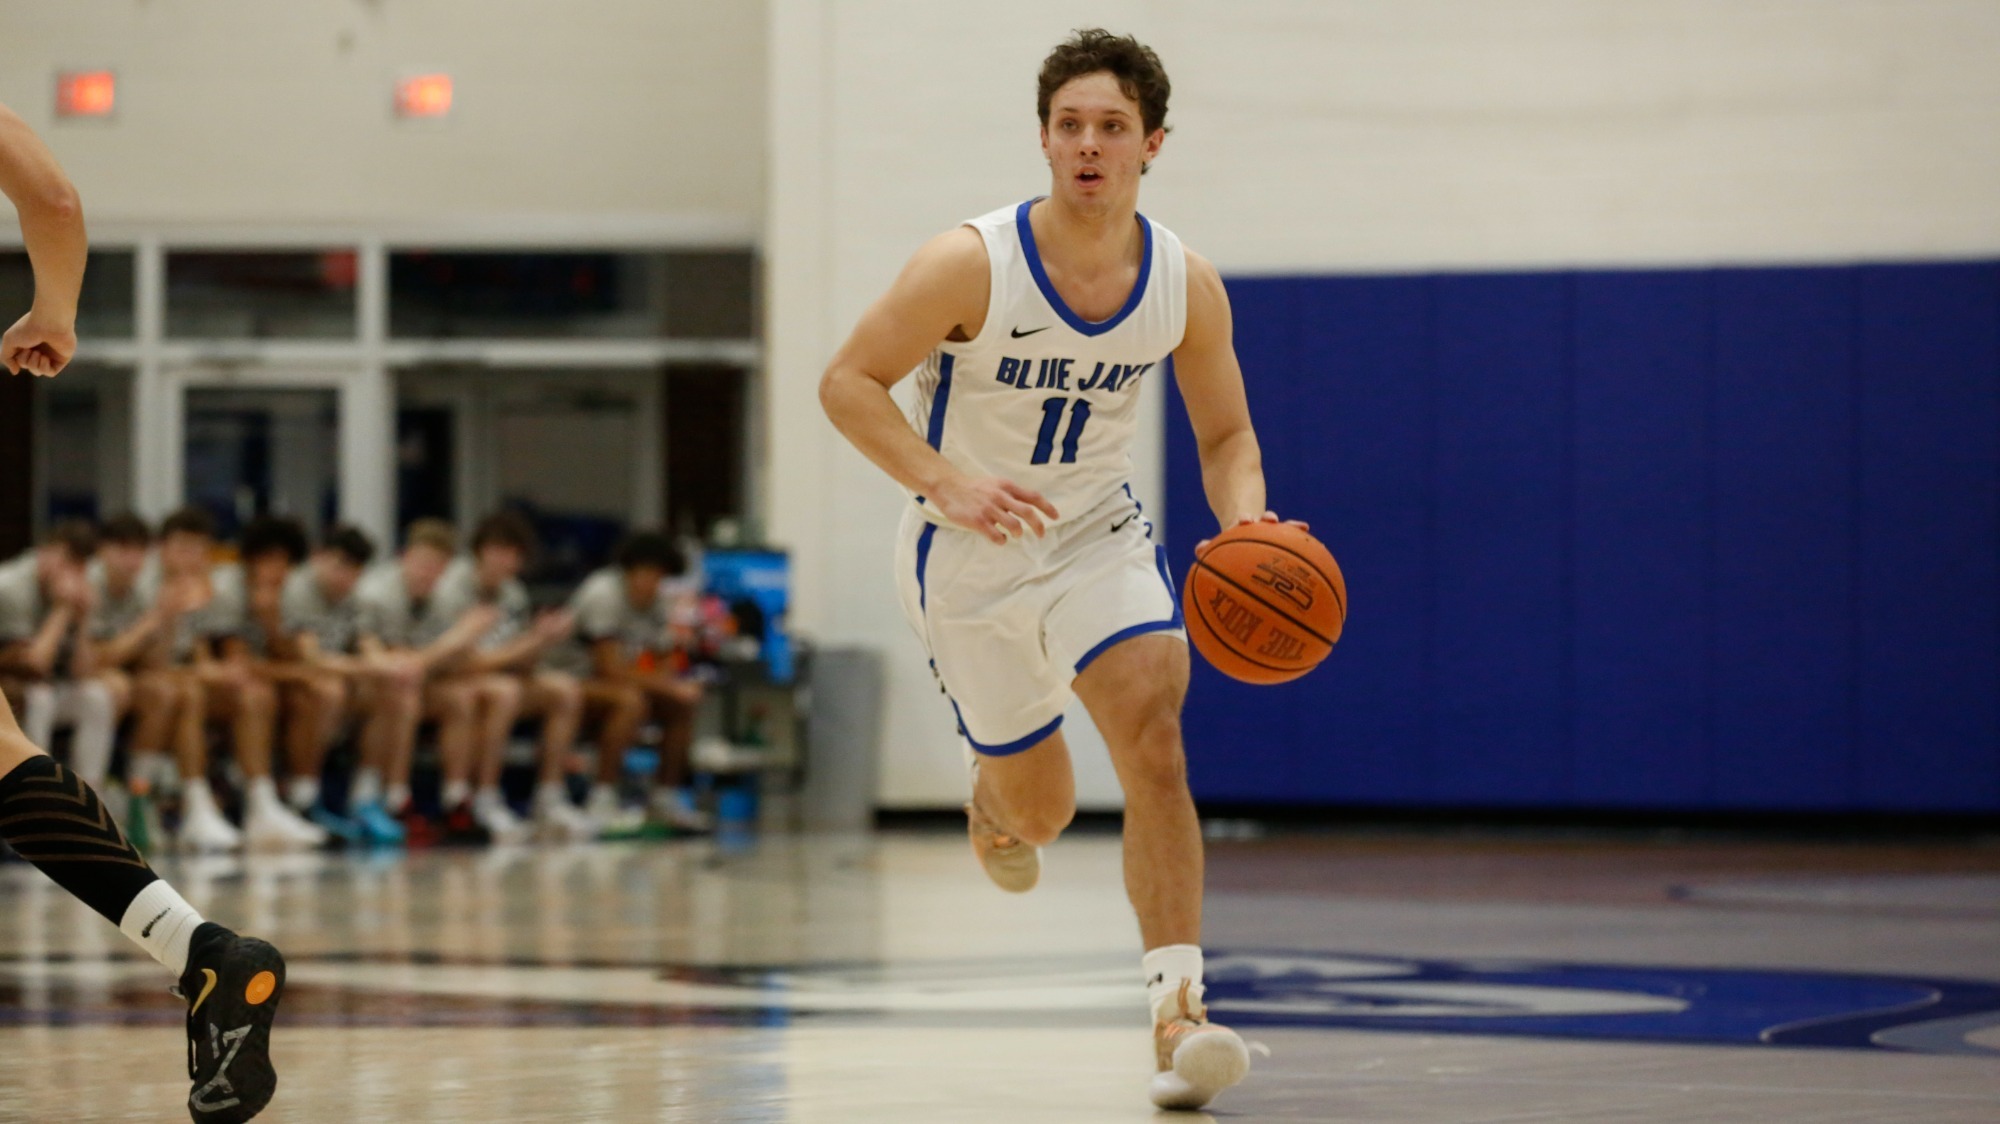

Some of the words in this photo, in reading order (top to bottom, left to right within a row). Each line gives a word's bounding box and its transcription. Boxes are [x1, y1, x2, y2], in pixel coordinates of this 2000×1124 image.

[996, 357, 1075, 391] BLUE
[1030, 397, 1092, 465] 11
[1208, 588, 1264, 646] ROCK
[1256, 626, 1307, 660] THE
